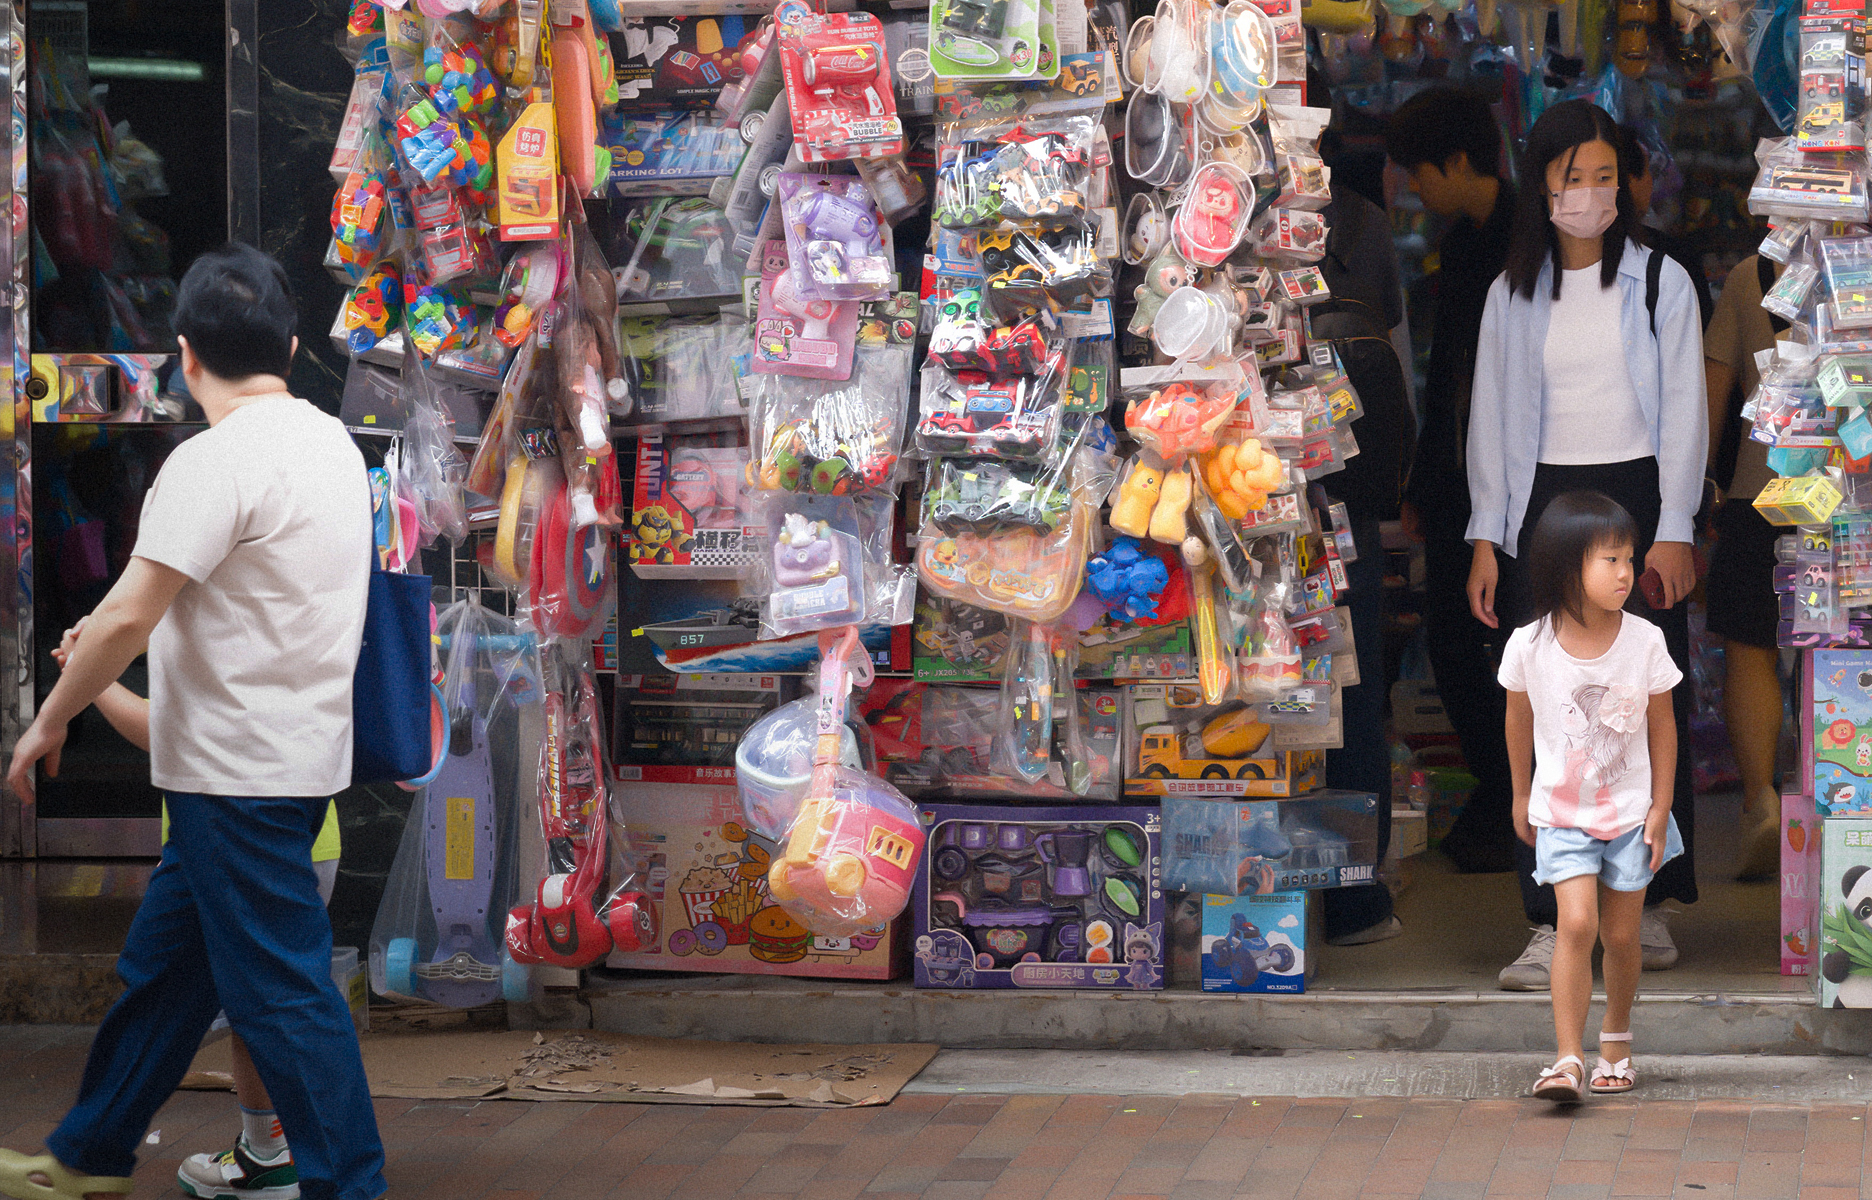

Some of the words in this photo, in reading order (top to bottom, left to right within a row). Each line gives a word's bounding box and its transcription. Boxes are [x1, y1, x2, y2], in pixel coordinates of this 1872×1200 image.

[900, 86, 934, 97] TRAIN
[853, 128, 883, 136] BUBBLE
[660, 167, 683, 175] LOT
[680, 635, 705, 645] 857
[1147, 814, 1160, 825] 3+
[1339, 865, 1374, 881] SHARK
